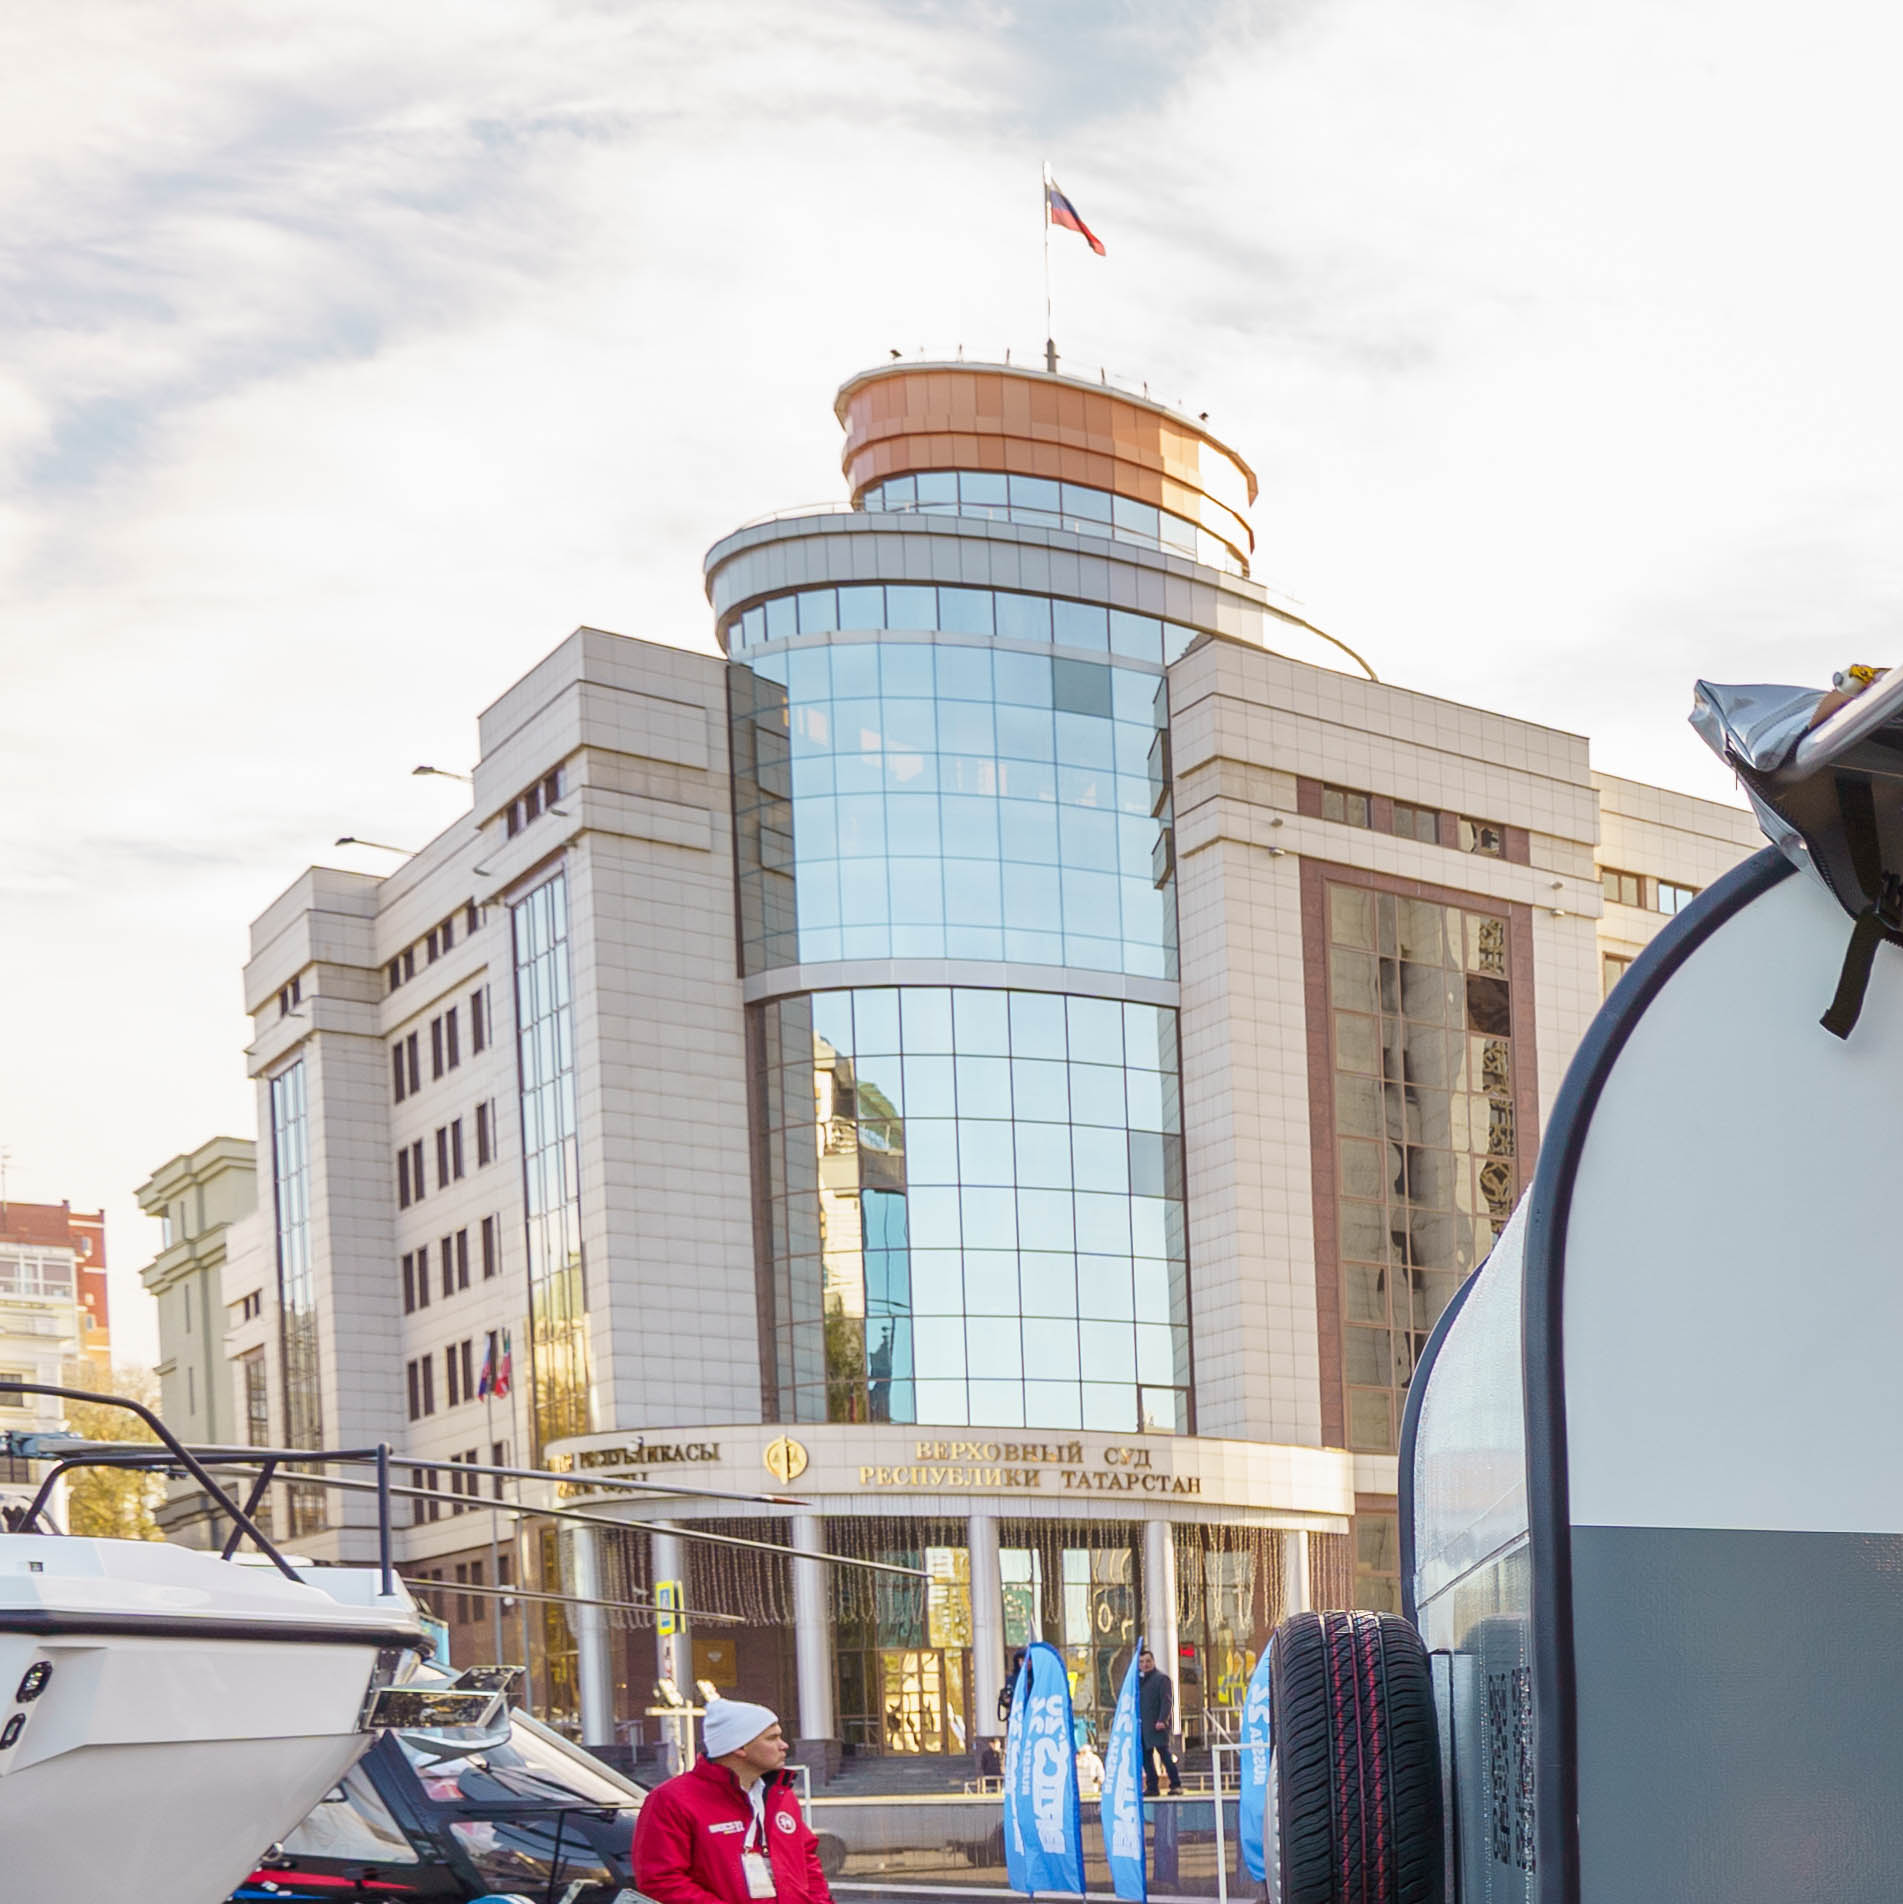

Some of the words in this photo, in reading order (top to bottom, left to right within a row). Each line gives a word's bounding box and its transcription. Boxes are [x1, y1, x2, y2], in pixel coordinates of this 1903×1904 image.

[915, 1440, 1084, 1465] ВЕРХОВНЫЙ
[1104, 1447, 1152, 1469] СУД
[858, 1466, 1041, 1487] РЕСПУБЛИКИ
[1061, 1470, 1201, 1494] ТАТАРСТАН
